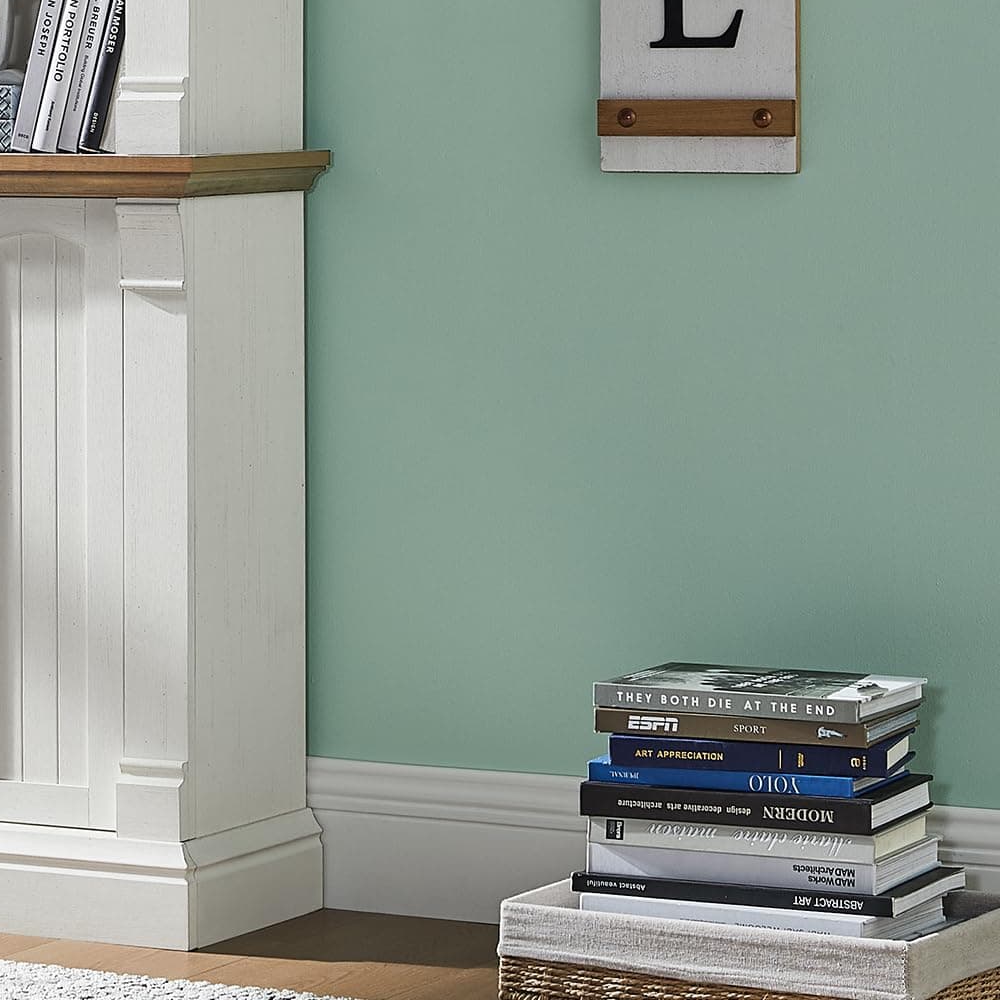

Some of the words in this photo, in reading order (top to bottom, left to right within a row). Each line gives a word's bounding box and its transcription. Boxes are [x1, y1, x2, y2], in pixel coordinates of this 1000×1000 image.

[37, 12, 53, 56] JOSEPH
[85, 6, 101, 49] BREUER
[105, 16, 119, 54] MOSER
[53, 11, 76, 82] PORTFOLIO
[89, 112, 99, 133] DESIGN
[616, 691, 652, 704] THEY
[660, 694, 699, 707] BOTH
[708, 697, 732, 709] DIE
[743, 700, 762, 711] AT
[771, 701, 797, 714] THE
[806, 704, 836, 716] END
[627, 715, 680, 732] ESPN
[733, 723, 768, 735] SPORT
[634, 749, 653, 758] ART
[656, 750, 724, 761] APPRECIATION
[749, 774, 801, 795] YOLO
[617, 799, 663, 810] architecture
[666, 802, 682, 811] arts
[683, 803, 722, 815] decorative
[726, 805, 752, 817] design
[762, 805, 834, 824] MODERN
[646, 823, 718, 841] maison
[730, 829, 788, 851] claire
[792, 863, 835, 876] Architects
[834, 867, 856, 878] MAD
[807, 874, 835, 887] Works
[834, 877, 856, 888] MAD
[792, 895, 812, 906] ART
[813, 896, 864, 911] ABSTRACT
